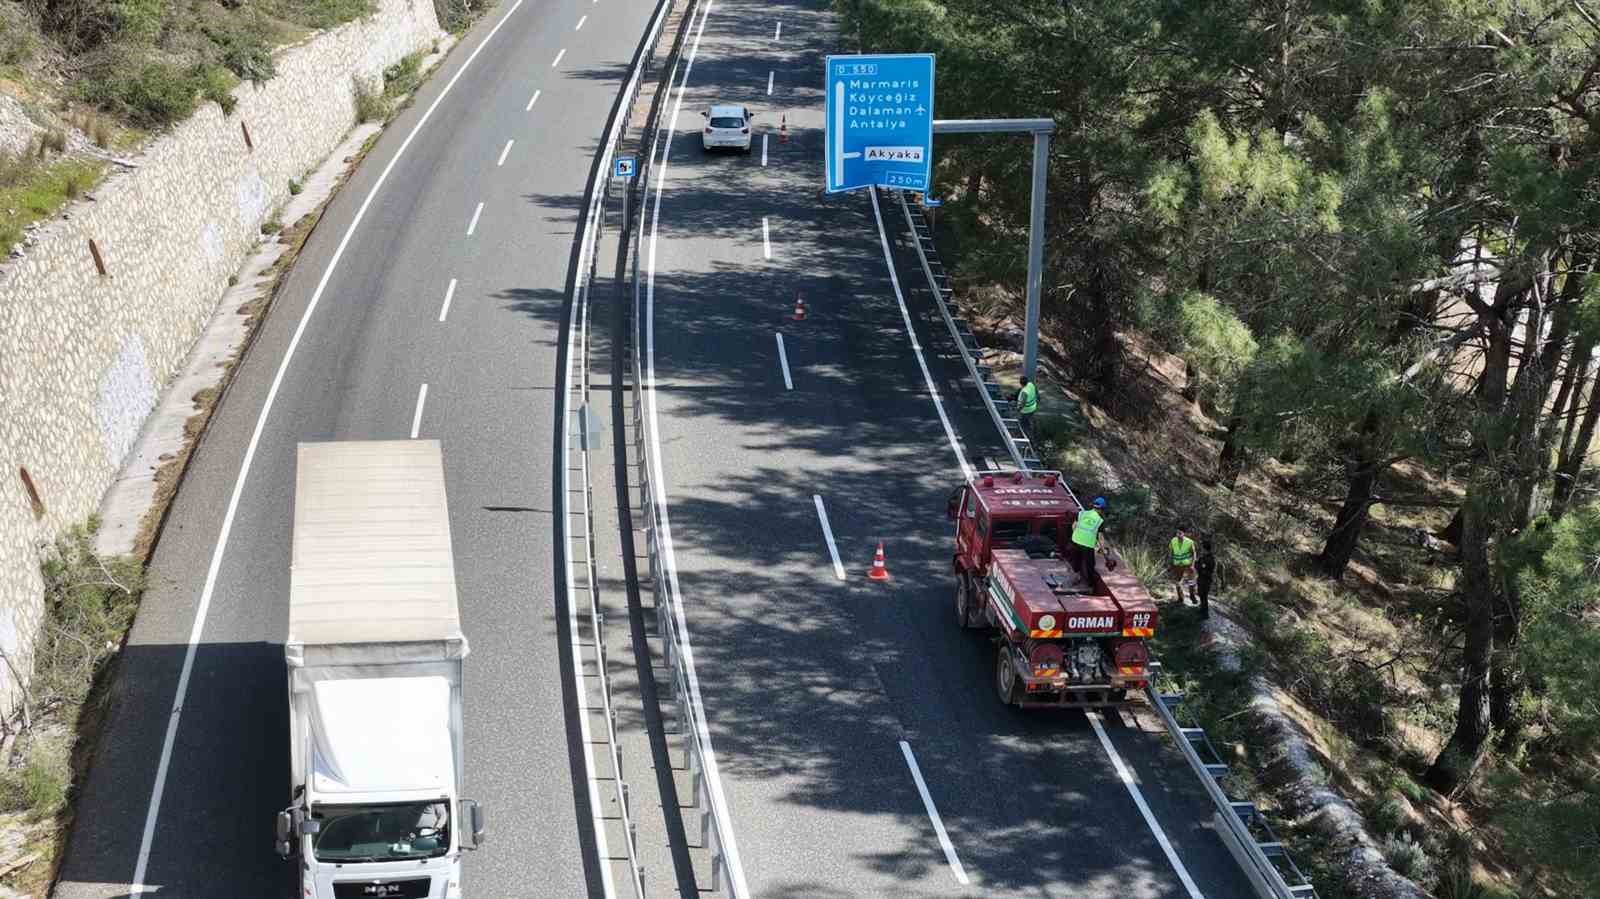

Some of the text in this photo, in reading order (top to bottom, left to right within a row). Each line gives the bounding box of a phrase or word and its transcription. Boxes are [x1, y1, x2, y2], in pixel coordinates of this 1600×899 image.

[849, 80, 919, 89] Marmaris
[849, 106, 912, 116] Dalaman
[849, 119, 906, 130] Antalya
[869, 149, 920, 160] Akyaka
[1068, 616, 1114, 629] ORMAN
[364, 884, 400, 893] MAN
